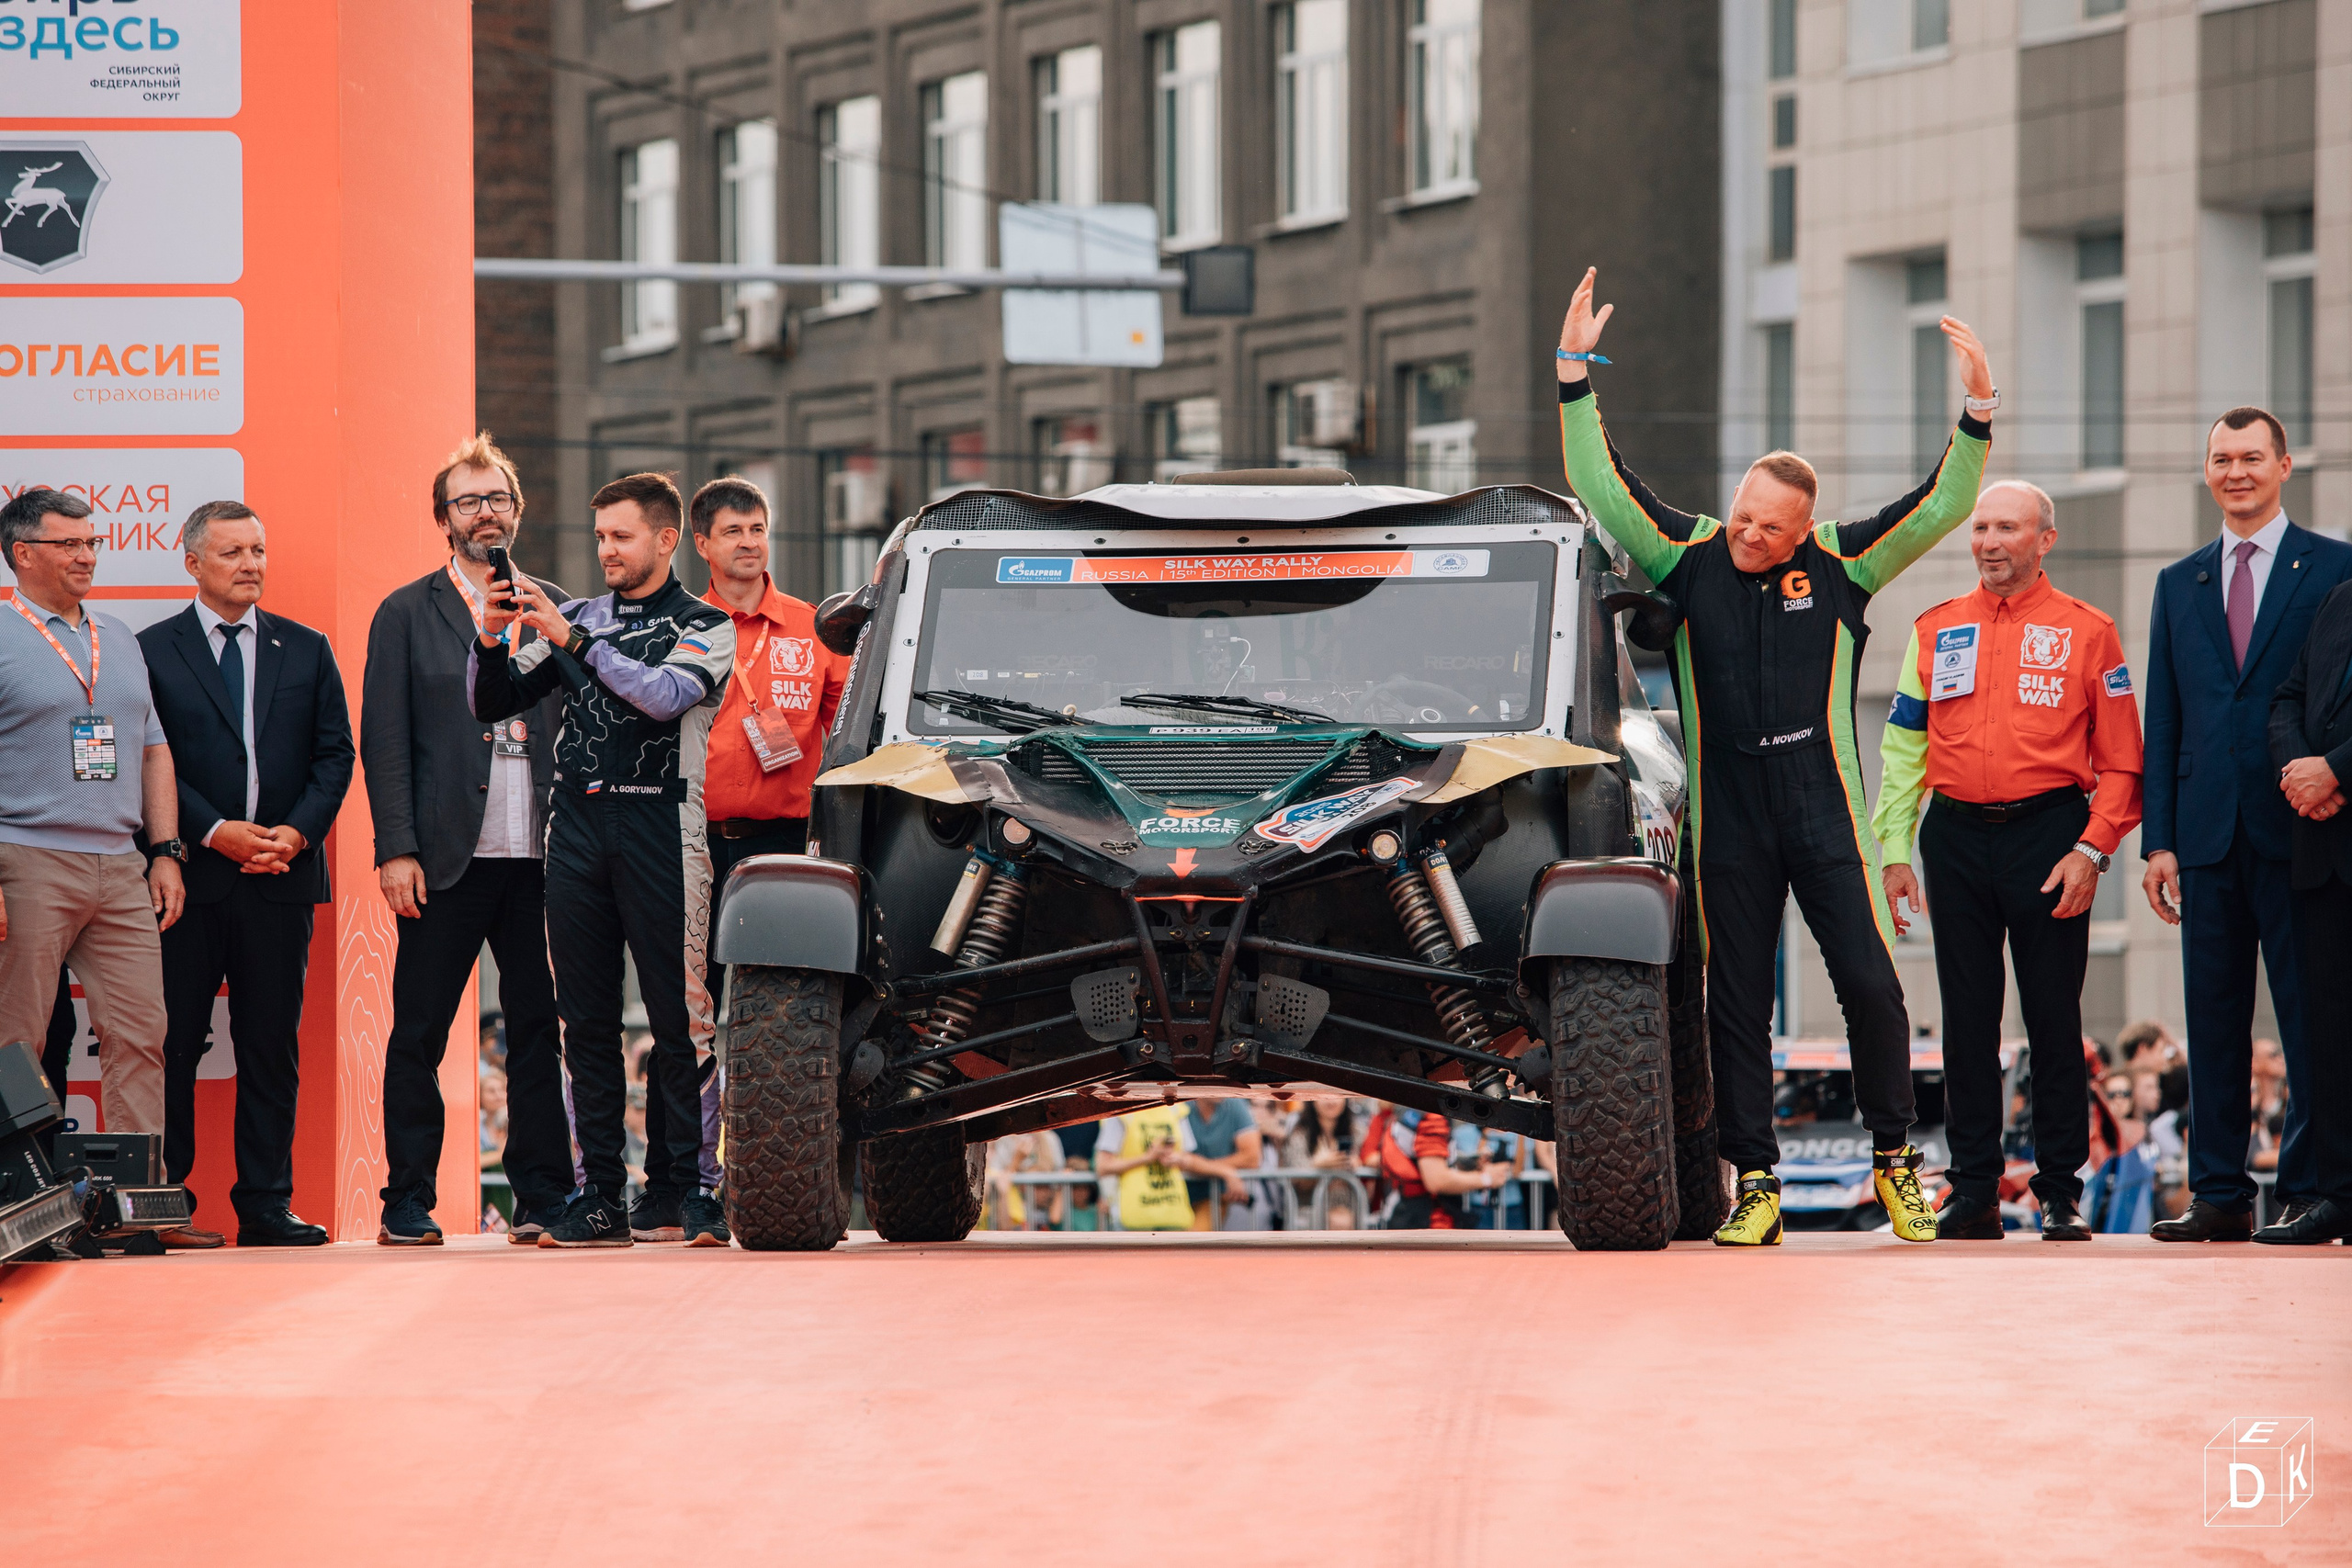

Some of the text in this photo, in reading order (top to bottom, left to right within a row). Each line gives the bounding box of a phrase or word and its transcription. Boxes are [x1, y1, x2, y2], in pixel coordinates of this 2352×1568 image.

[0, 16, 180, 60] здесь
[108, 63, 181, 75] СИБИРСКИЙ
[90, 76, 181, 90] ФЕДЕРАЛЬНЫЙ
[142, 92, 181, 102] ОКРУГ
[73, 387, 221, 406] страхование
[1164, 556, 1324, 570] SILK WAY RALLY
[1080, 563, 1405, 581] RUSSIA 15th EDITION MONGOLIA
[1783, 596, 1814, 608] FORCE
[1425, 654, 1505, 671] RECARO
[771, 680, 812, 697] SILK
[2018, 673, 2065, 693] SILK
[772, 694, 812, 710] WAY
[2018, 689, 2064, 708] WAY
[1771, 727, 1815, 746] NOVIKOV
[505, 743, 523, 754] VIP
[763, 750, 800, 768] ORGANIZATION
[609, 784, 663, 795] A. GORYUNOV
[1278, 809, 1332, 836] SILK
[1329, 788, 1376, 810] WAY
[1138, 827, 1240, 835] MOTORSPORT
[1139, 817, 1242, 829] FORCE
